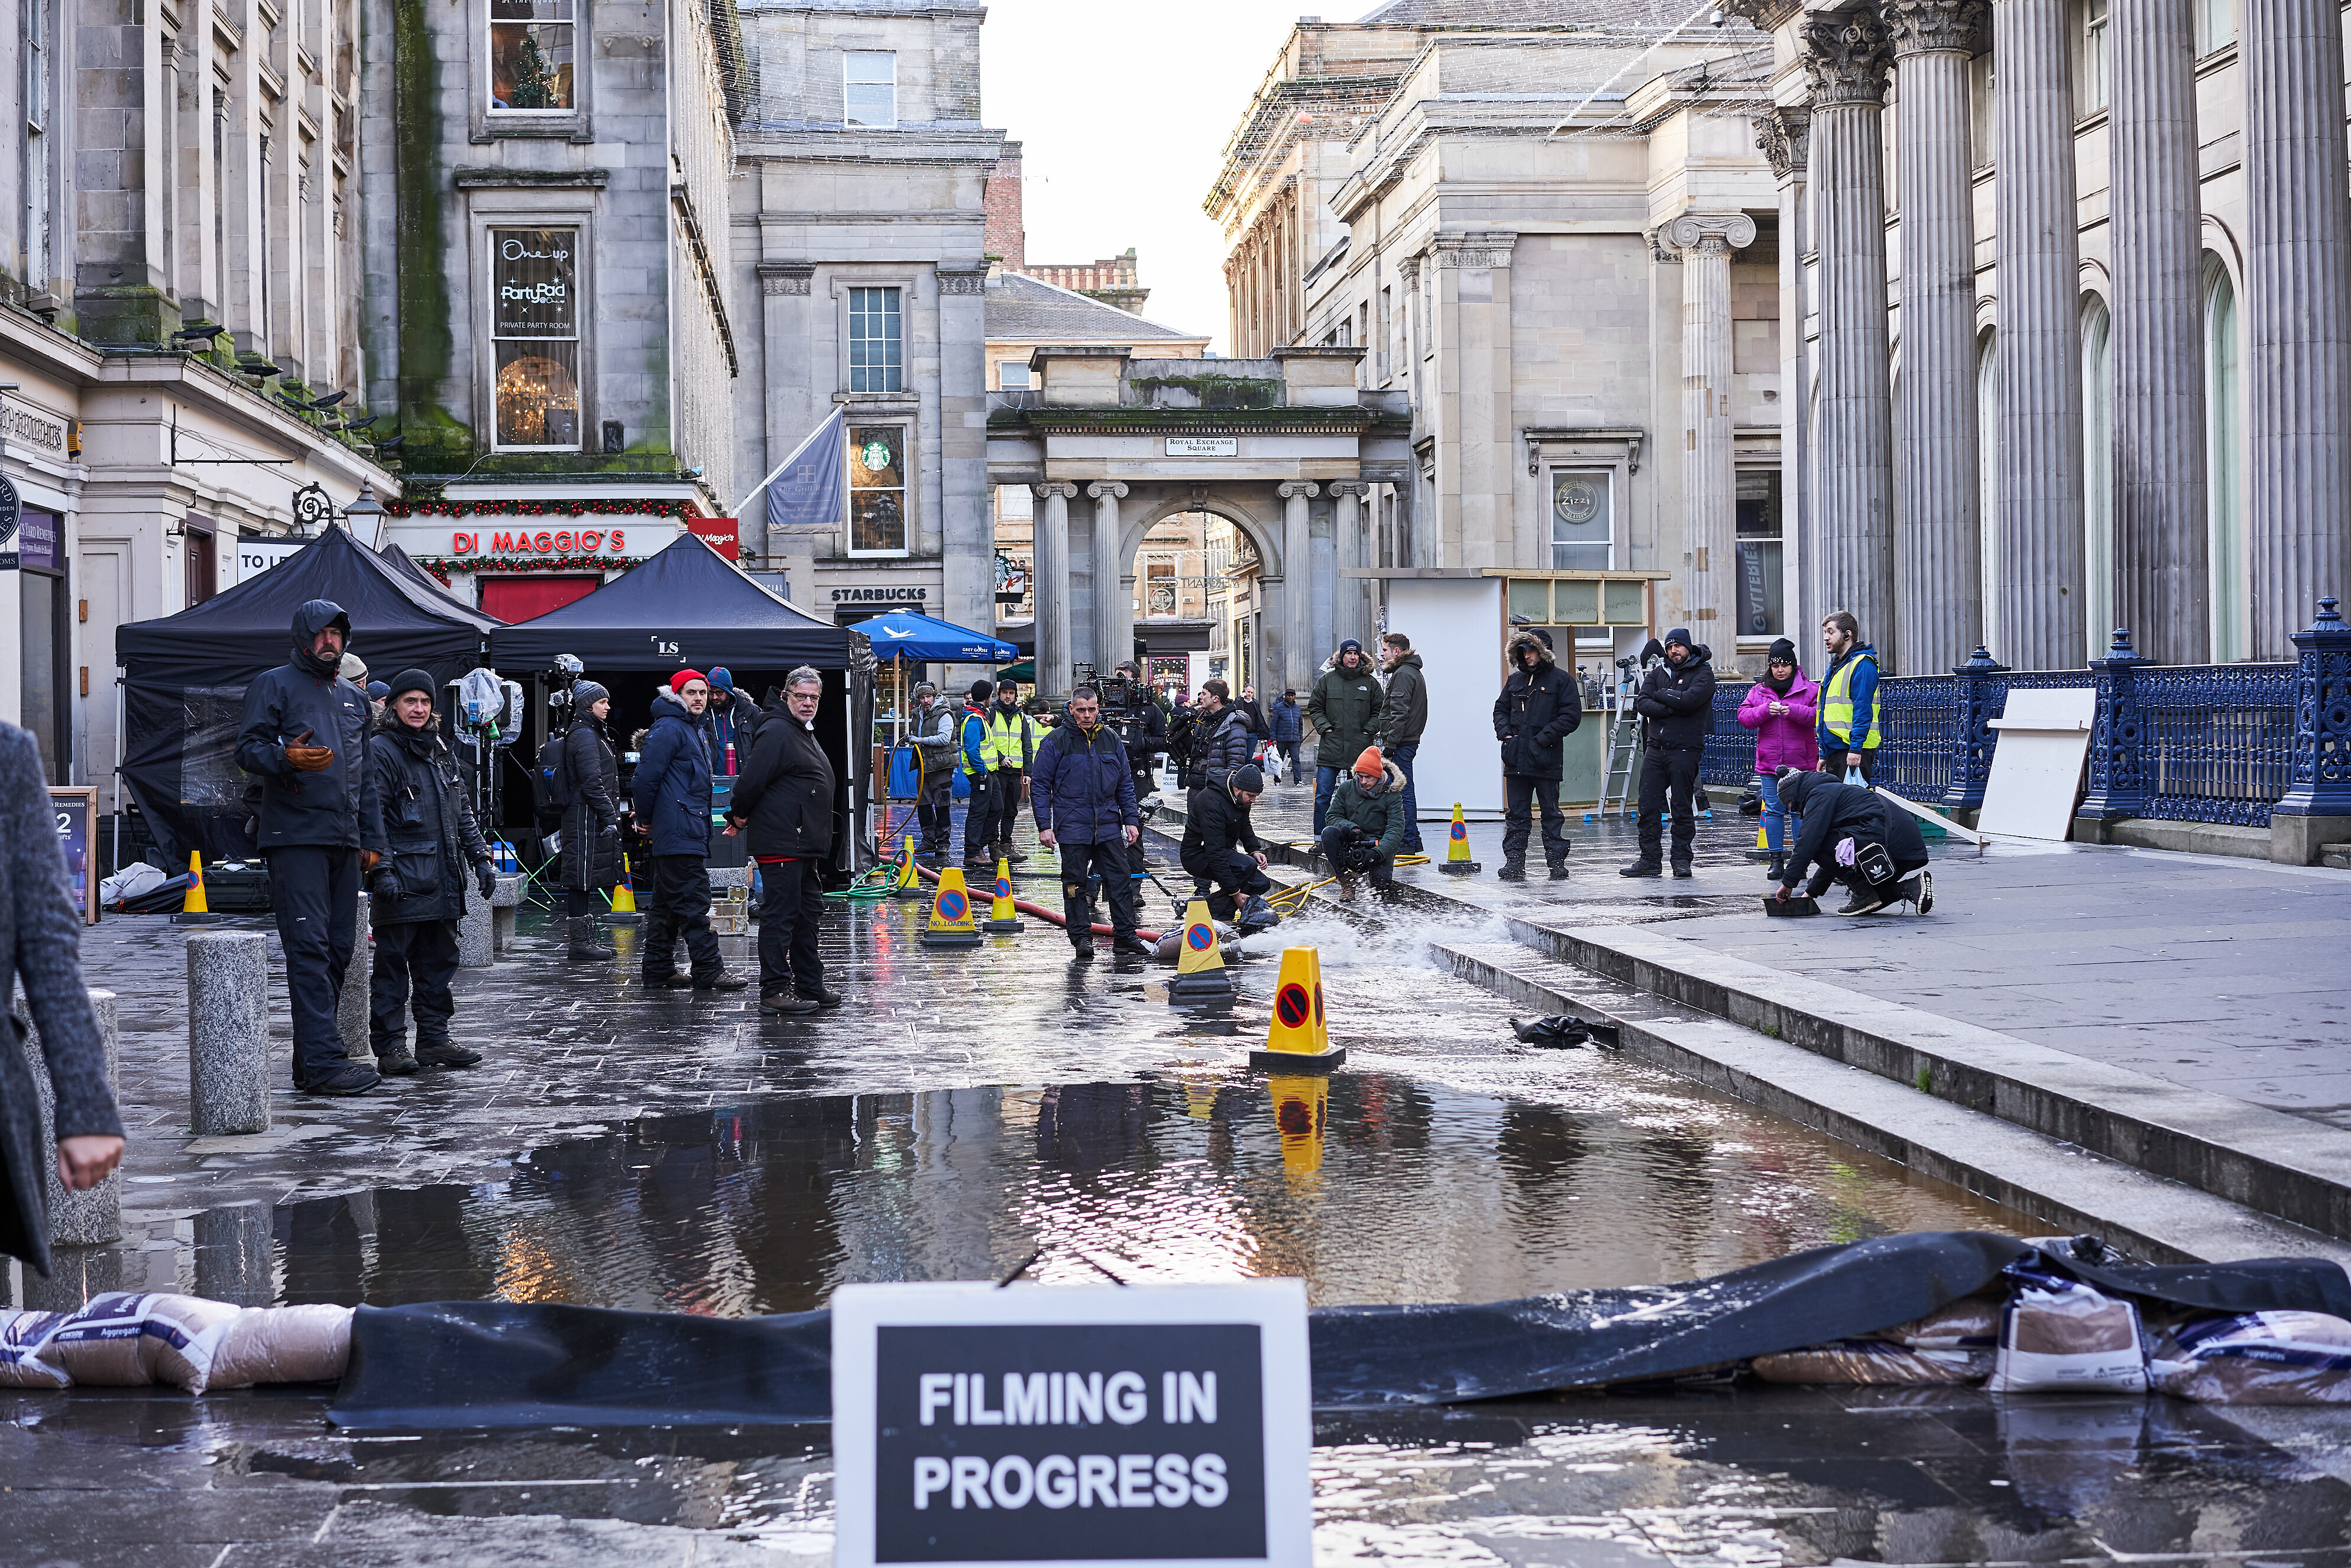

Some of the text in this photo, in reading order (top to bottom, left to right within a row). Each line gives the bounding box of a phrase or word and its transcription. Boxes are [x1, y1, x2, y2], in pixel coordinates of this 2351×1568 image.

[503, 239, 569, 262] One up
[1562, 483, 1573, 493] ROYAL
[1562, 496, 1589, 506] Zizzi
[25, 522, 36, 538] YARD
[36, 525, 56, 543] REMEDIES
[704, 533, 734, 545] Maggio's
[454, 529, 626, 553] DI MAGGIO'S
[241, 555, 264, 568] TO
[831, 588, 927, 601] STARBUCKS
[658, 642, 679, 654] LS
[1873, 871, 1886, 879] adidas
[919, 1371, 1217, 1427] FILMING IN
[913, 1454, 1229, 1511] PROGRESS
